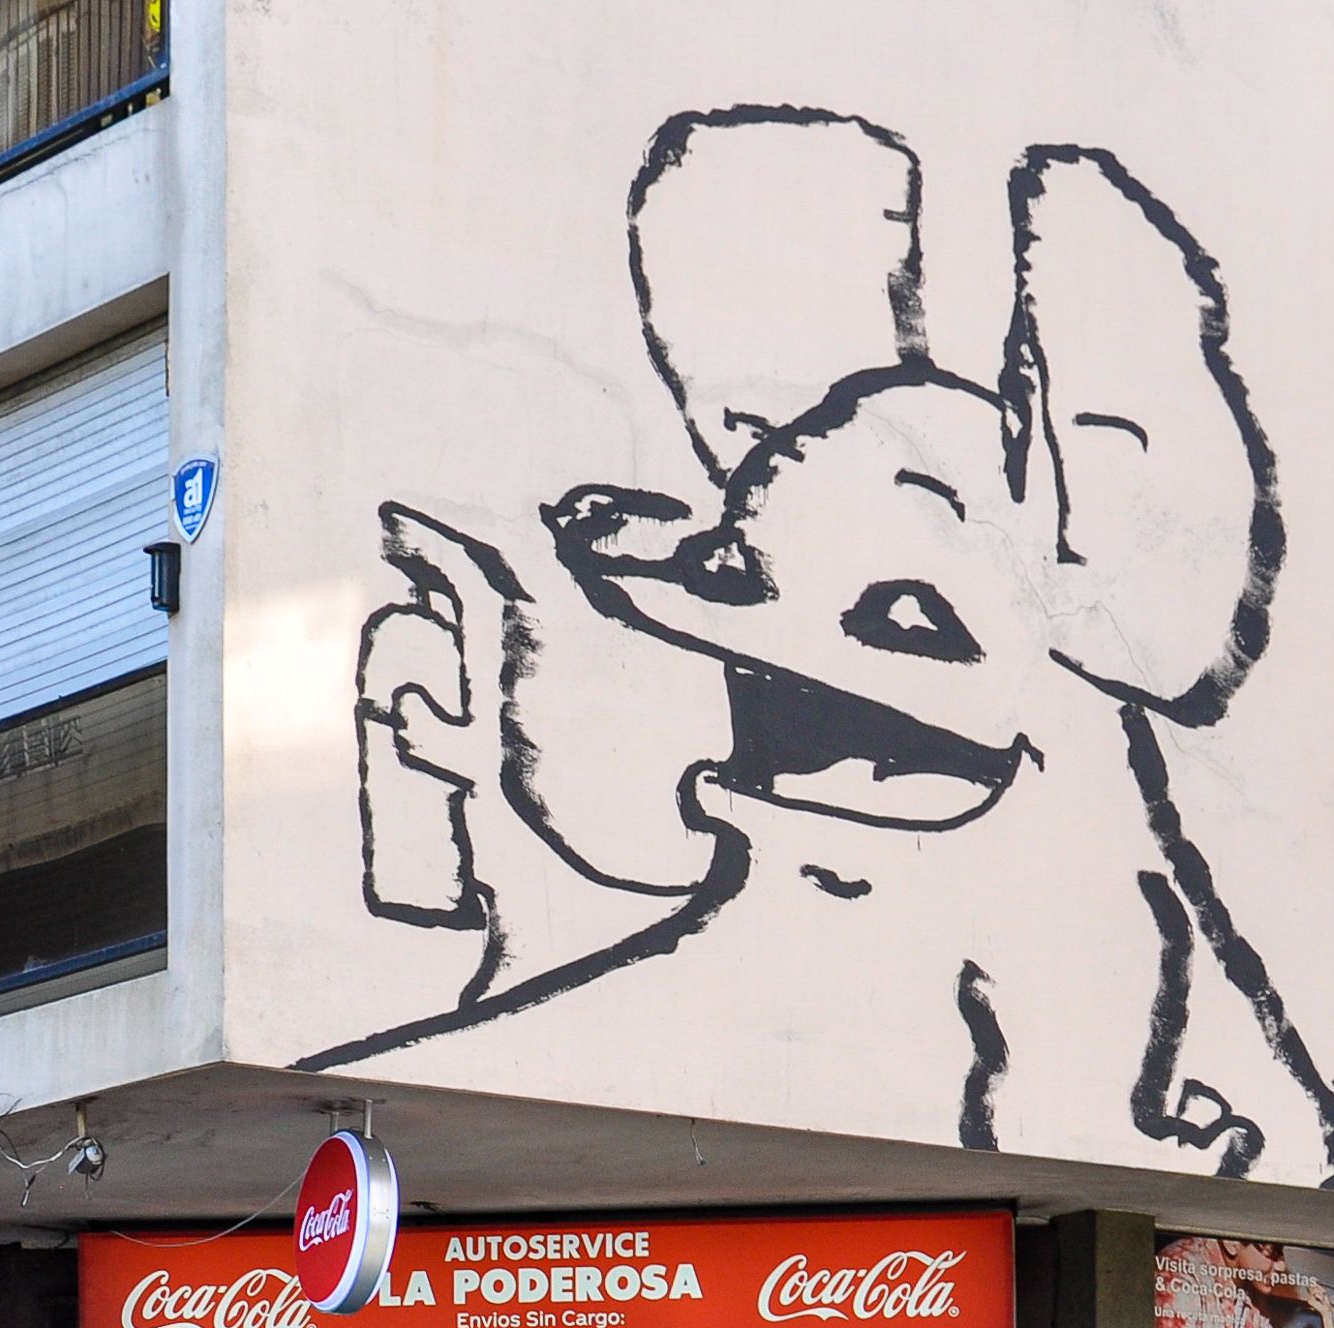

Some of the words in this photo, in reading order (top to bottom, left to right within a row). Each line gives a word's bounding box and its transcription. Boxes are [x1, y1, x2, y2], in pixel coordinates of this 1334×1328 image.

[299, 1188, 354, 1252] Coca-Cola
[444, 1232, 650, 1262] AUTOSERVICE
[378, 1271, 436, 1306] LA
[453, 1263, 703, 1305] PODEROSA
[758, 1250, 967, 1322] Coca-Cola
[1155, 1255, 1196, 1275] Visita
[1200, 1264, 1267, 1283] sorpresa,
[1271, 1272, 1318, 1288] pastas
[1155, 1276, 1166, 1291] &
[457, 1311, 521, 1328] Envios
[526, 1310, 556, 1327] Sin
